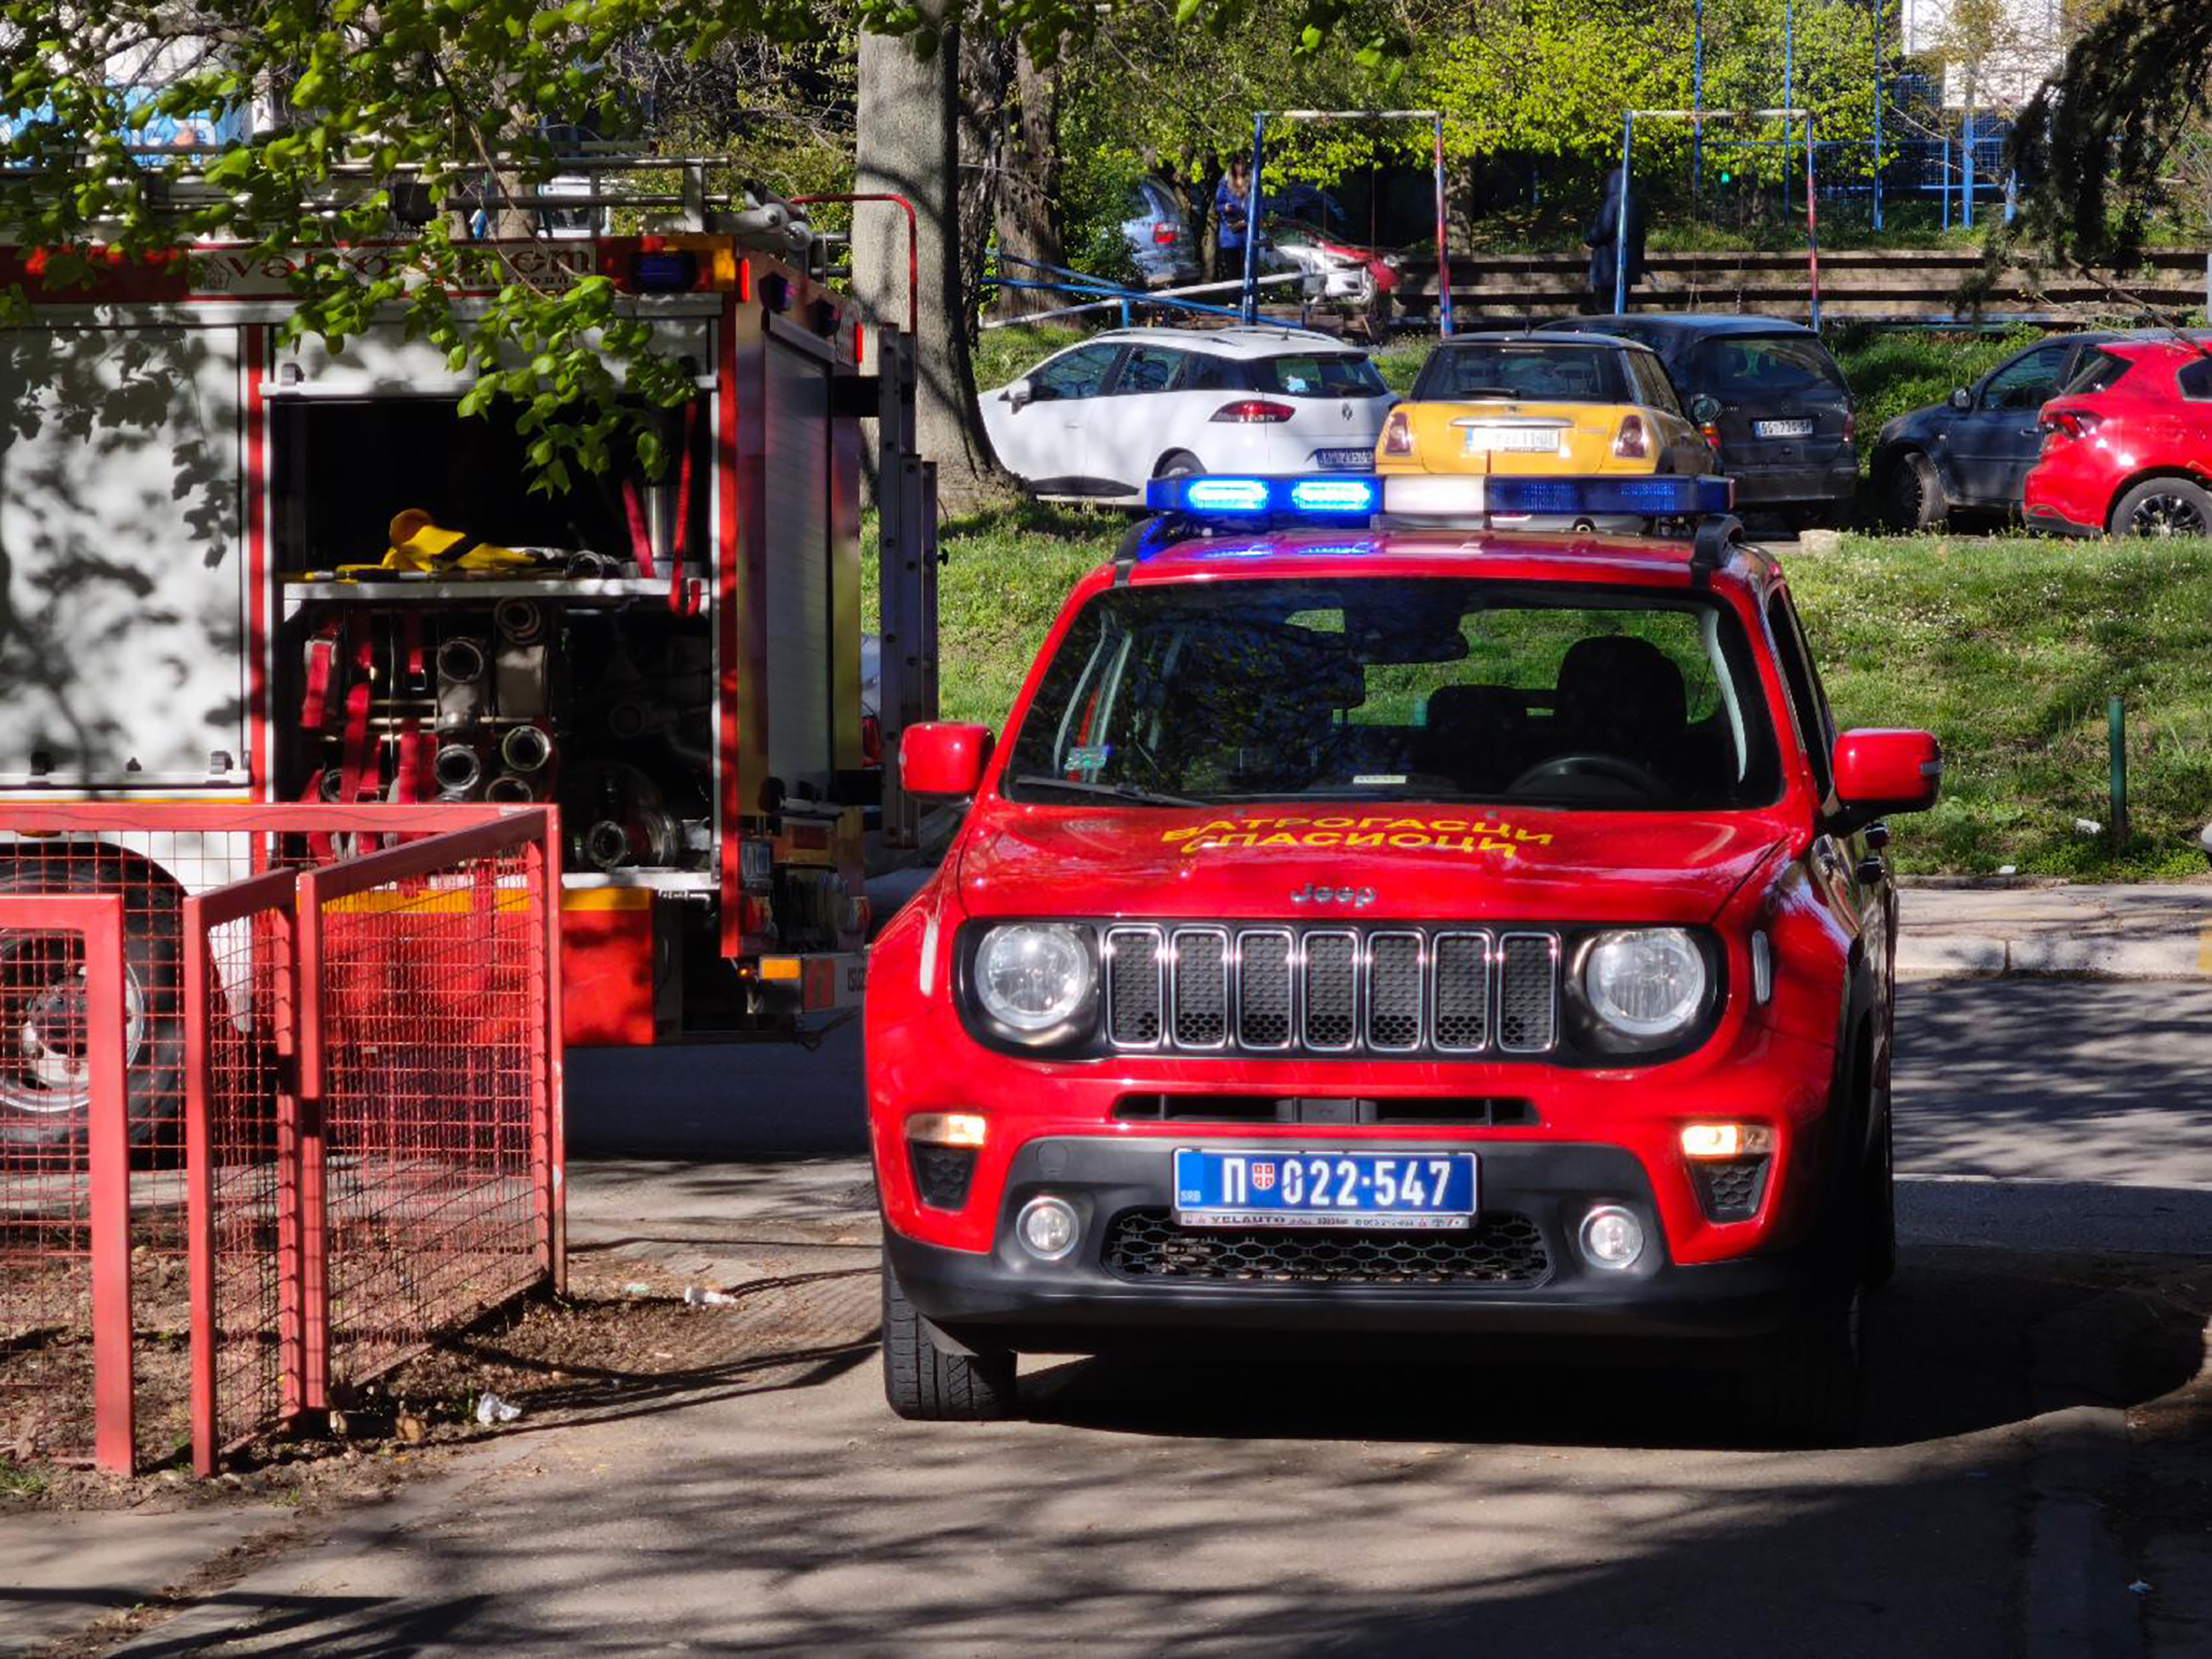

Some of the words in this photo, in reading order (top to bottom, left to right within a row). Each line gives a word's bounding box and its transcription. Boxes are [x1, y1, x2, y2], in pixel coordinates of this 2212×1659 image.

[1180, 832, 1517, 858] СПАСИОЦИ
[1291, 883, 1377, 908] Jeep
[1179, 1190, 1202, 1203] SRB
